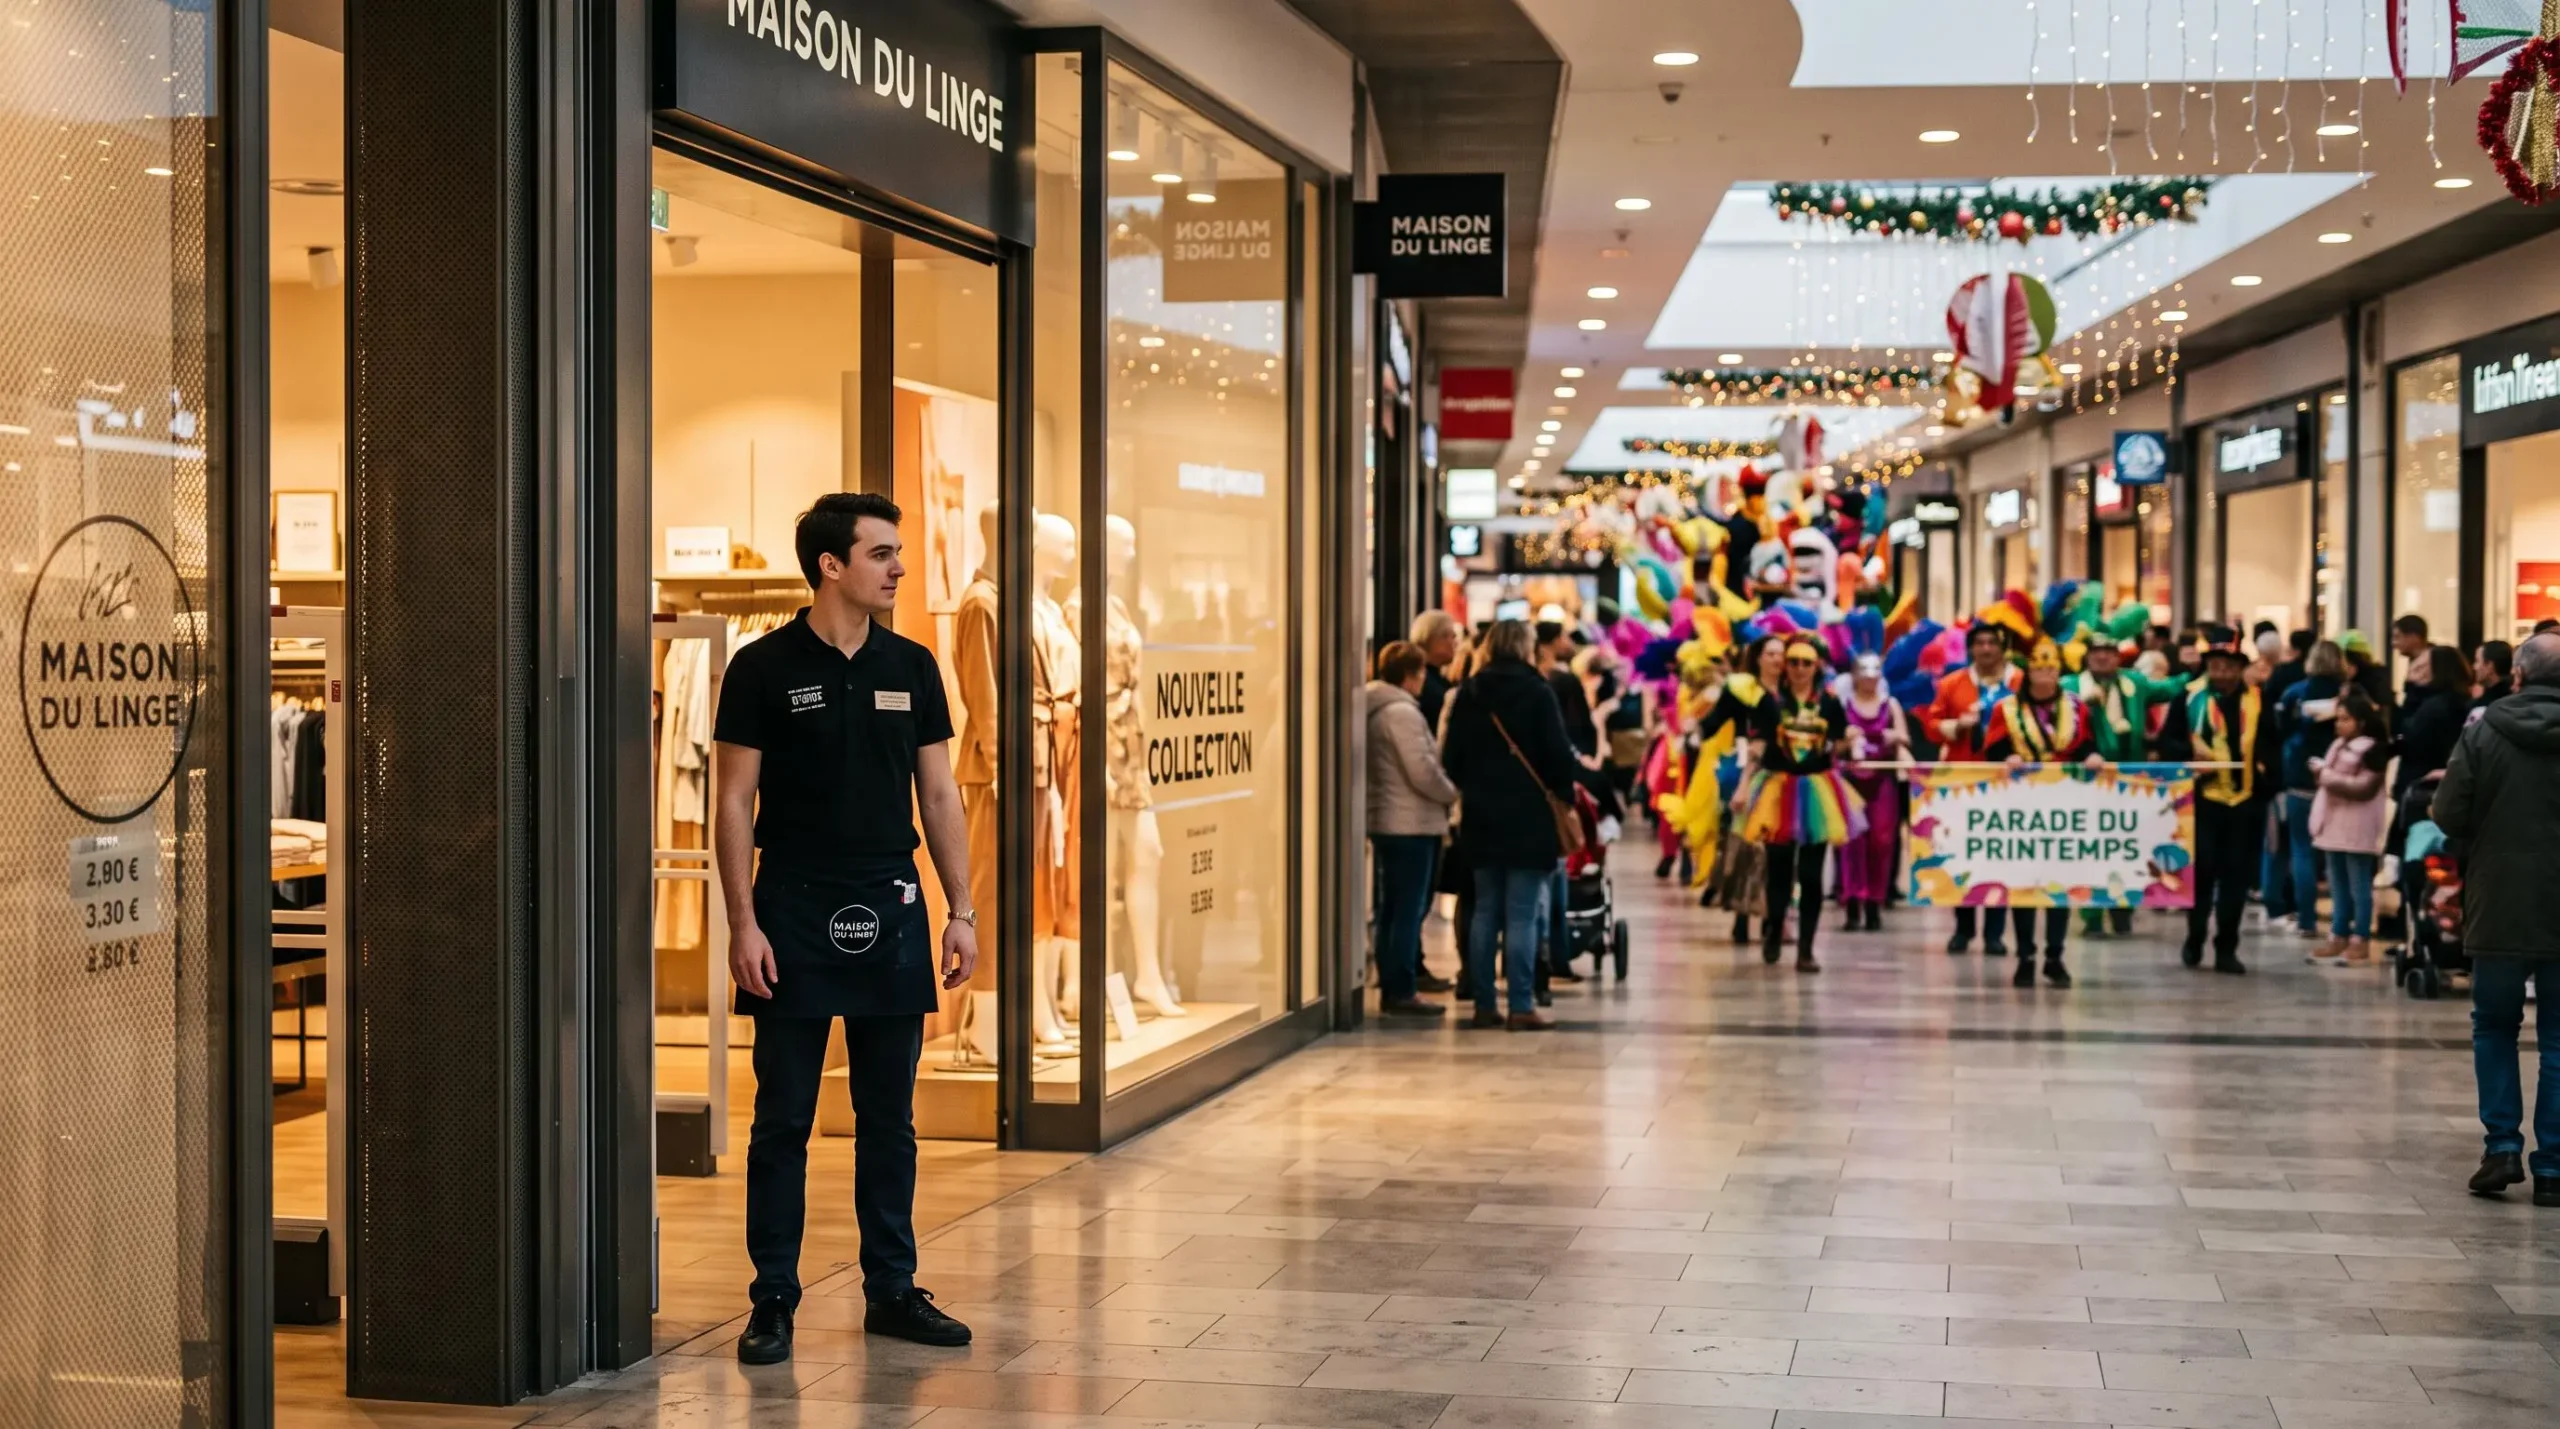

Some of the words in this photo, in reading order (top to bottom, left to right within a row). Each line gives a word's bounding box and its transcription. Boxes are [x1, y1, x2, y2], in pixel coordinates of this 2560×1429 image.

[874, 37, 915, 109] DU
[925, 63, 1003, 153] LINGE
[1391, 214, 1491, 235] MAISON
[1391, 238, 1421, 256] DU
[1428, 236, 1492, 255] LINGE
[41, 641, 178, 682] MAISON
[1157, 671, 1244, 719] NOUVELLE
[41, 696, 82, 729] DU
[94, 695, 180, 728] LINGE
[1148, 730, 1252, 786] COLLECTION
[1967, 809, 2087, 832] PARADE
[2099, 809, 2138, 832] DU
[1966, 837, 2140, 861] PRINTEMPS
[86, 899, 124, 929] 3,30
[129, 898, 139, 921] €
